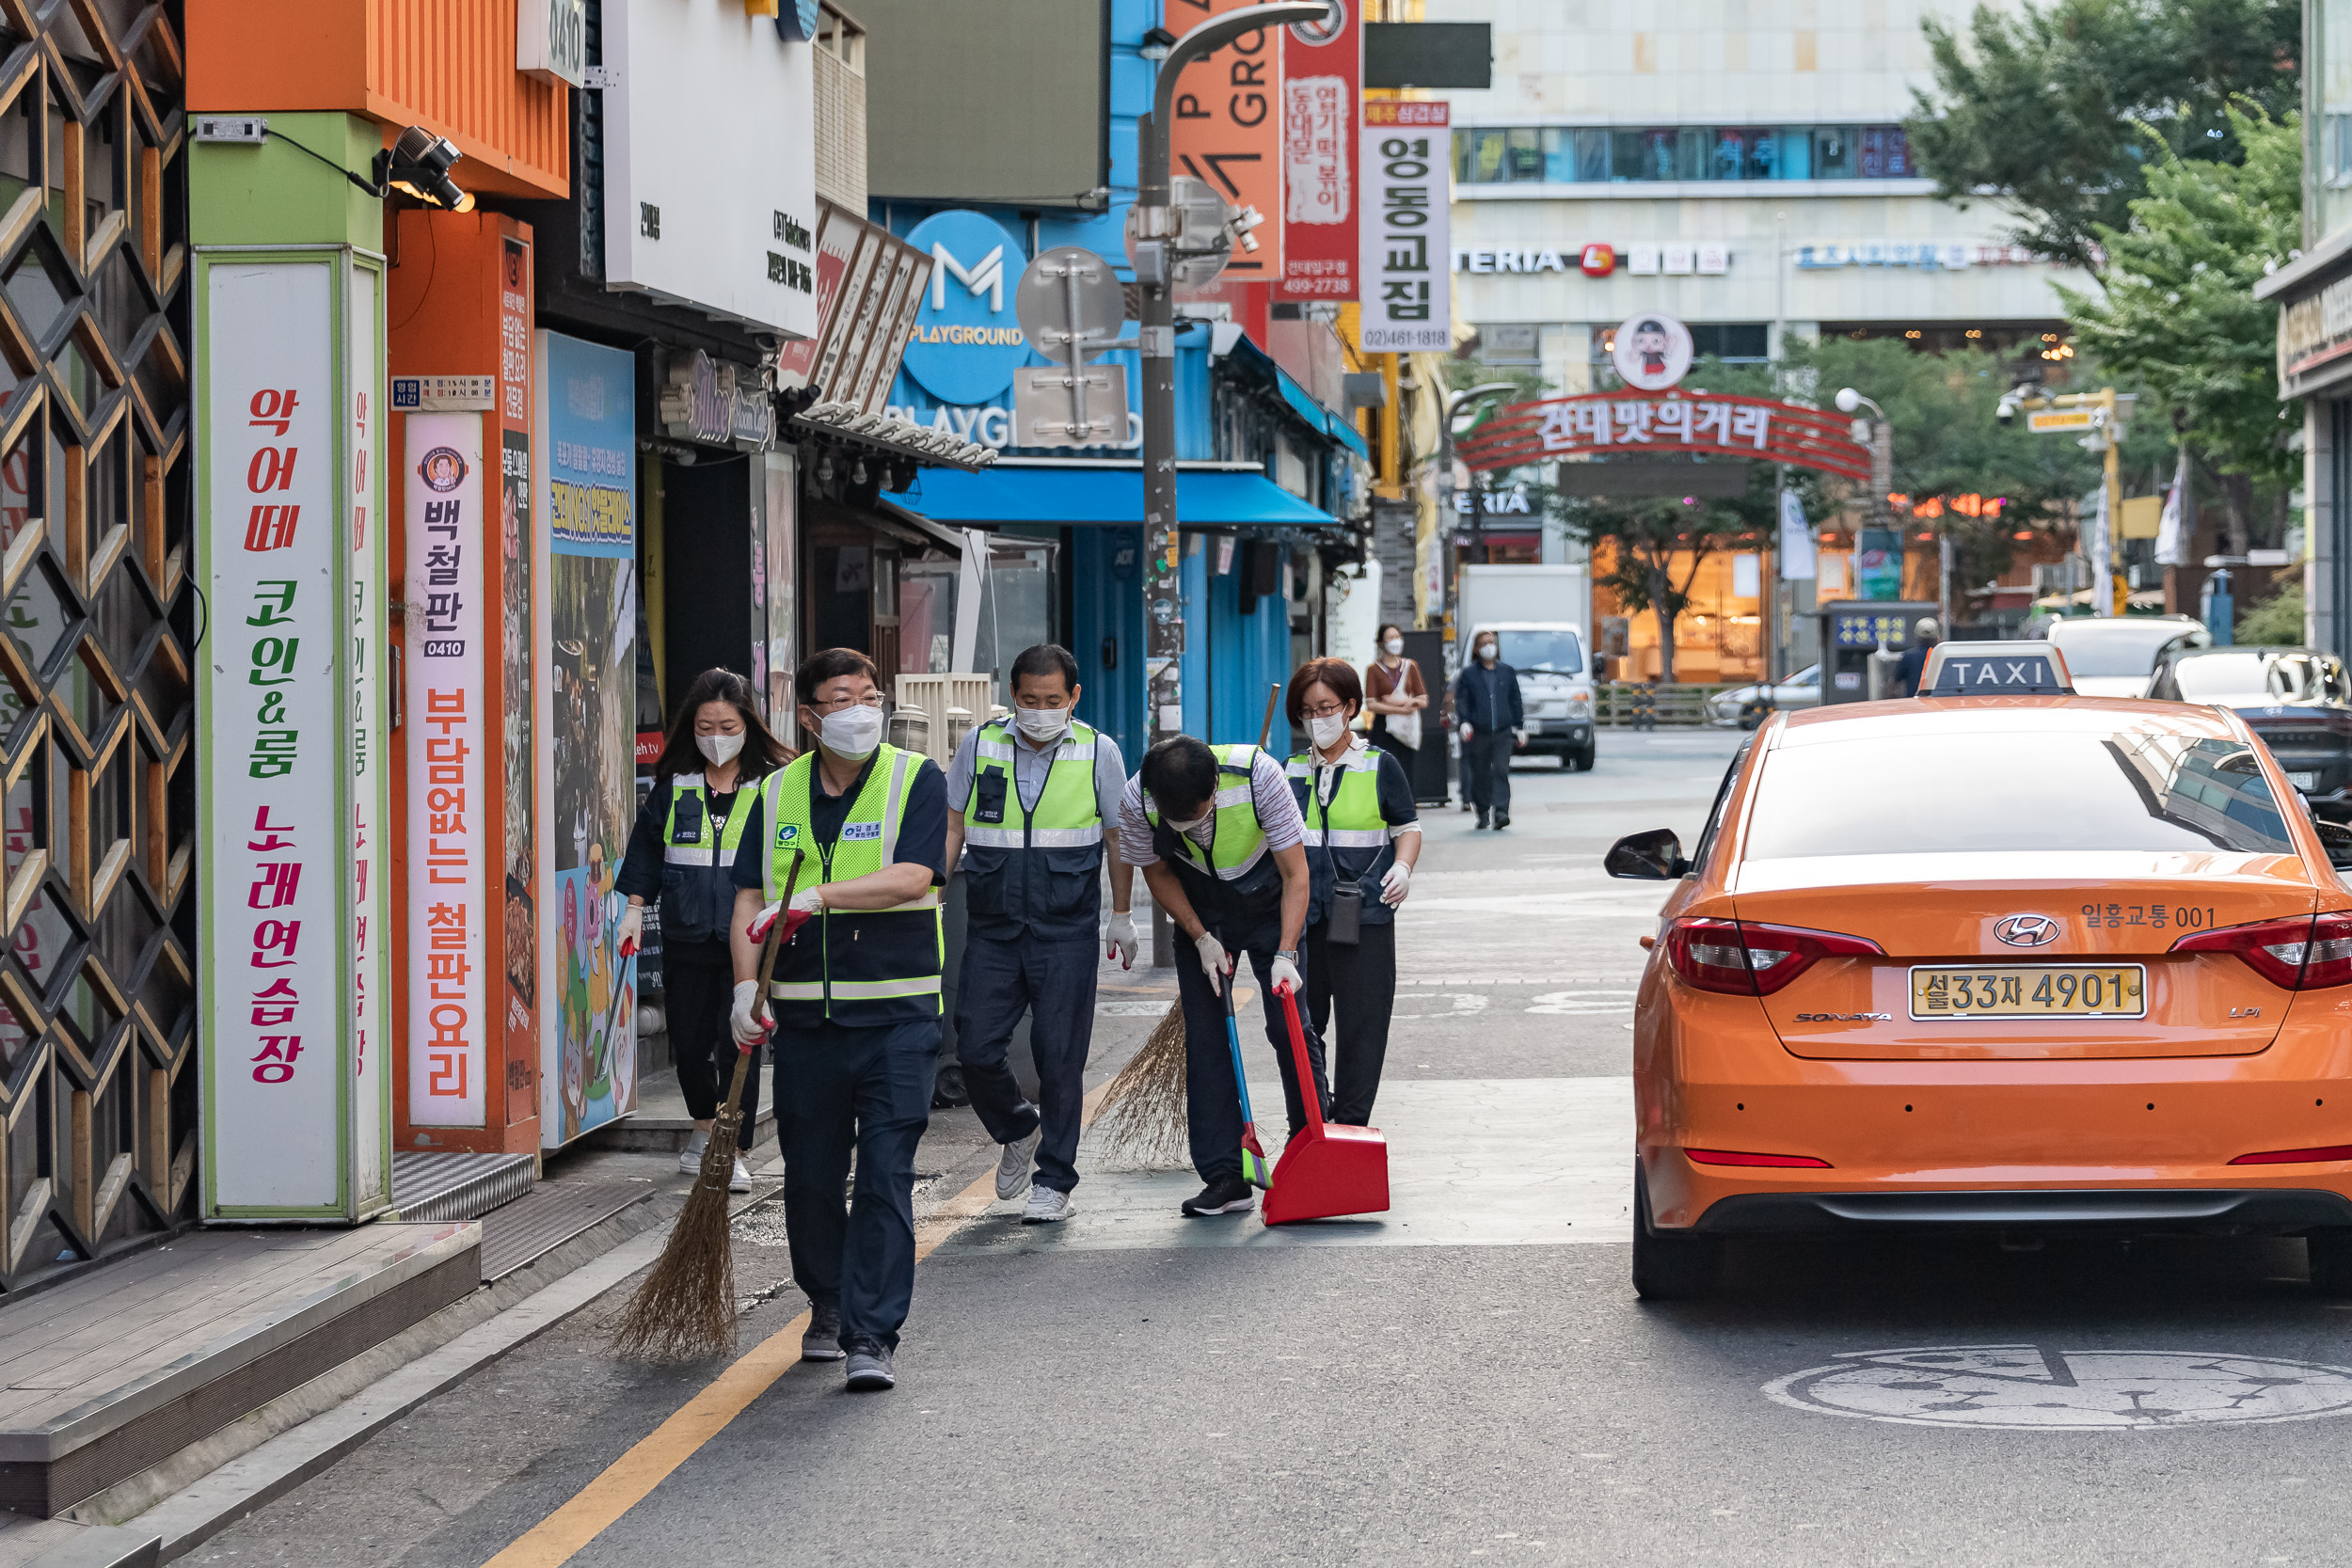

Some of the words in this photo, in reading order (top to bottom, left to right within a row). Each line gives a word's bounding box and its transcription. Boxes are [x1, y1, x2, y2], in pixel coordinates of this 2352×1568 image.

[550, 0, 580, 73] 0410
[1291, 87, 1312, 165] 동대문
[1316, 87, 1338, 214] 엽기떡볶이
[1378, 138, 1429, 321] 영동교집
[1287, 260, 1347, 276] 건대입구점
[1283, 278, 1350, 293] 499-2738
[910, 325, 1025, 345] PLAYGROUND
[1365, 330, 1446, 347] 02)461-1818
[397, 382, 417, 392] 영업
[397, 393, 417, 404] 시간
[506, 386, 523, 420] 전문점
[243, 388, 300, 552] 악어떼
[592, 447, 606, 473] 휴양지
[616, 451, 627, 476] 술집
[517, 480, 528, 509] 한판
[551, 478, 570, 539] 건대
[591, 481, 632, 546] 핫플레이스
[424, 499, 462, 631] 백철판
[427, 642, 462, 656] 0410
[246, 579, 300, 779] 코인&룸
[1952, 663, 2042, 686] TAXI
[648, 742, 659, 754] tv
[426, 688, 468, 885] 부담없는
[2081, 904, 2169, 928] 일흥교통
[2176, 908, 2215, 927] 001
[246, 805, 304, 1084] 노래연습장
[427, 901, 470, 1100] 철판요리
[2032, 974, 2122, 1008] 4901
[1793, 1011, 1892, 1022] SONATA
